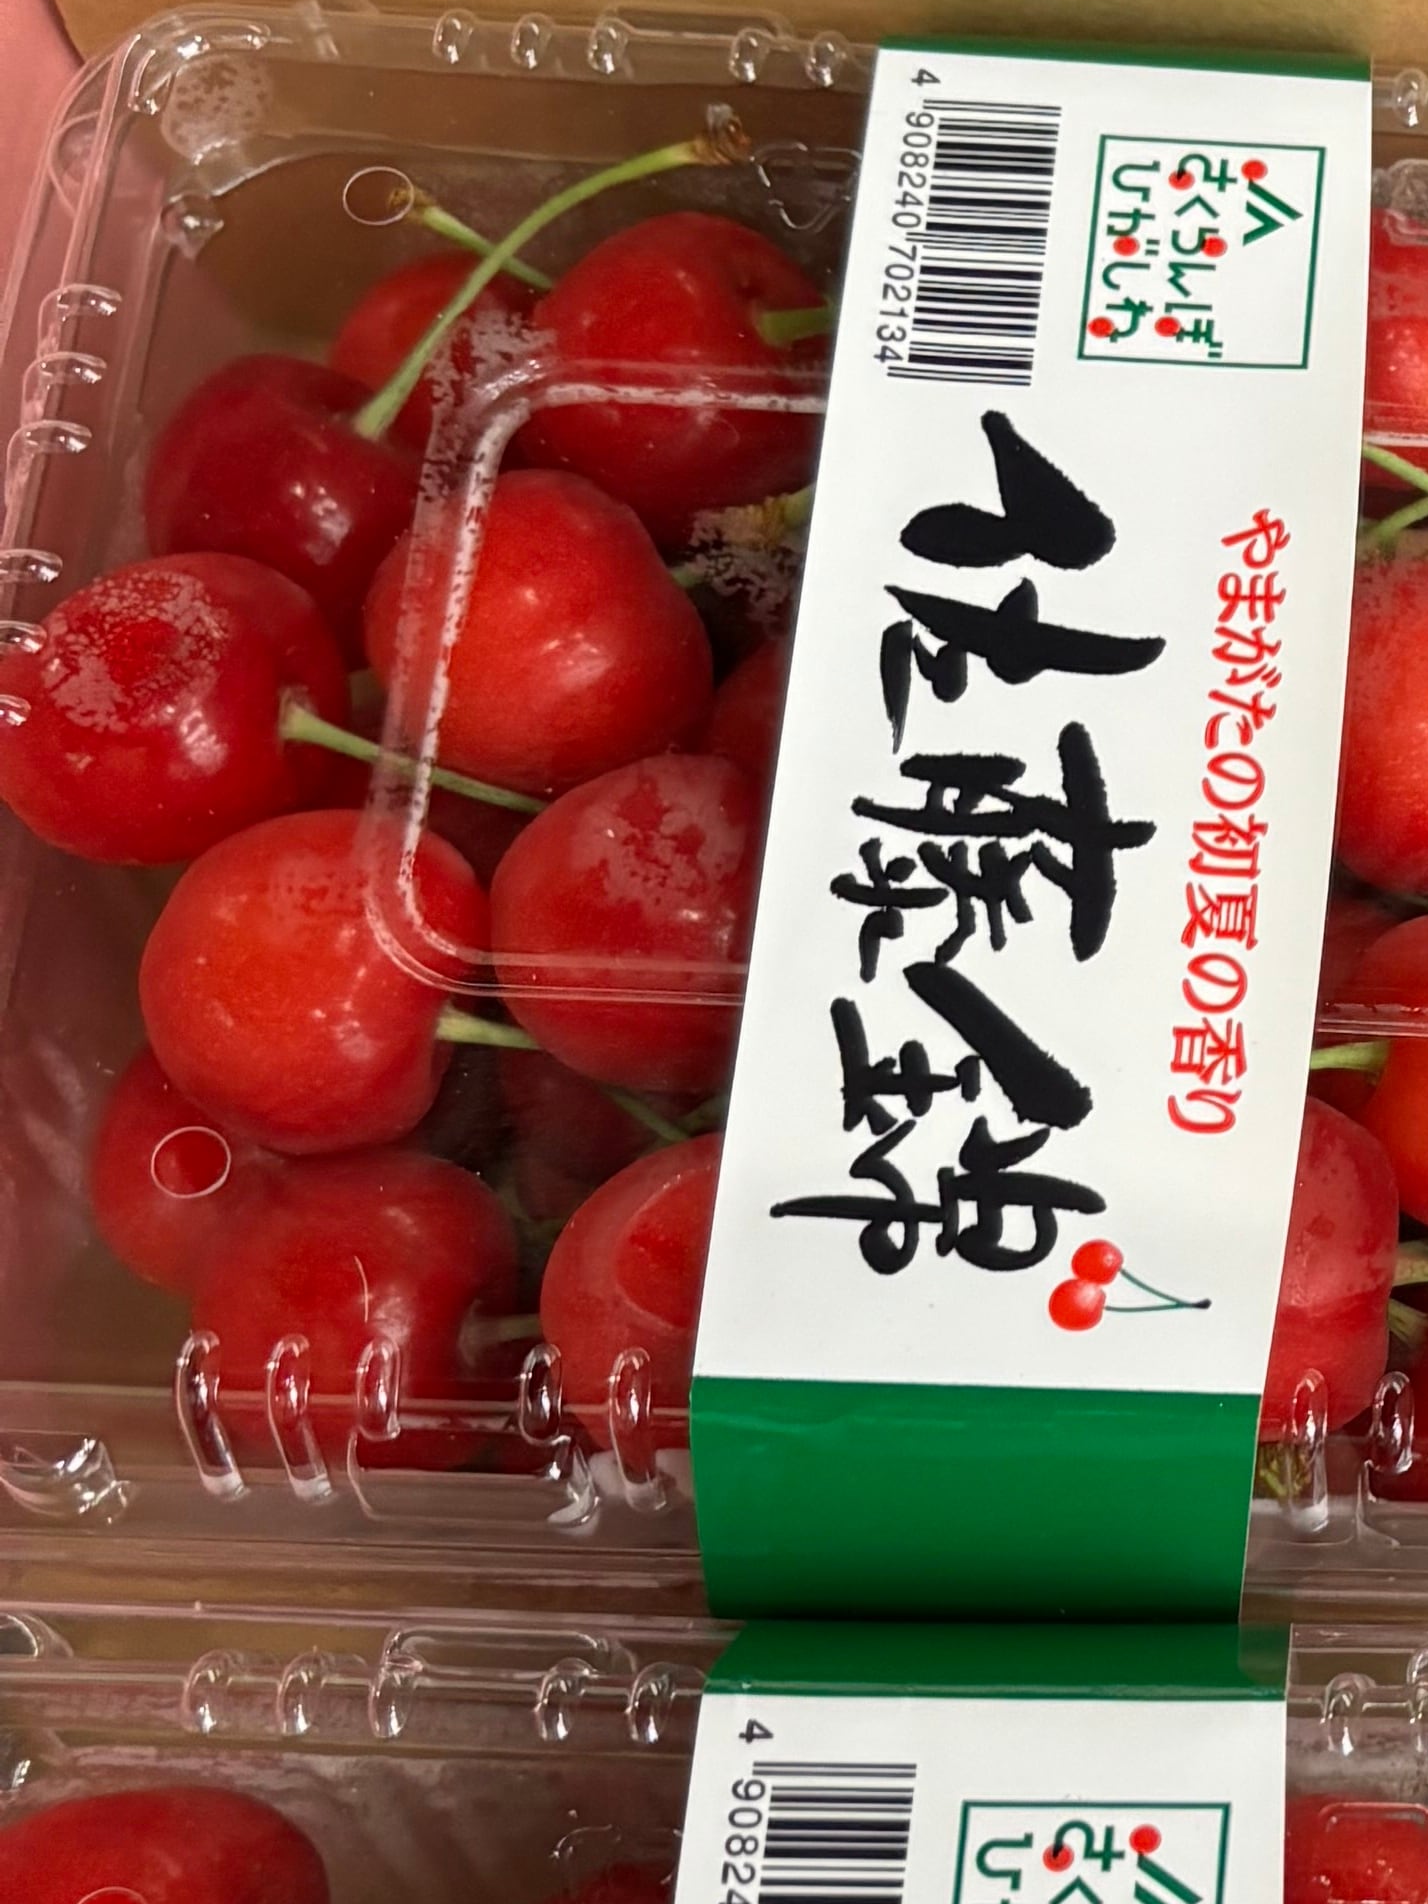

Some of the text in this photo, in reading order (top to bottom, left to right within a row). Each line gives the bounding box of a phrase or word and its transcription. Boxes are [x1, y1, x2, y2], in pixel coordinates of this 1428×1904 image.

[873, 69, 941, 363] 4 908240 702134
[1155, 153, 1238, 359] さくらんぼ
[770, 411, 1165, 1275] 佐藤錦
[1166, 508, 1291, 1135] やまがたの初夏の香り
[739, 1719, 774, 1744] 4
